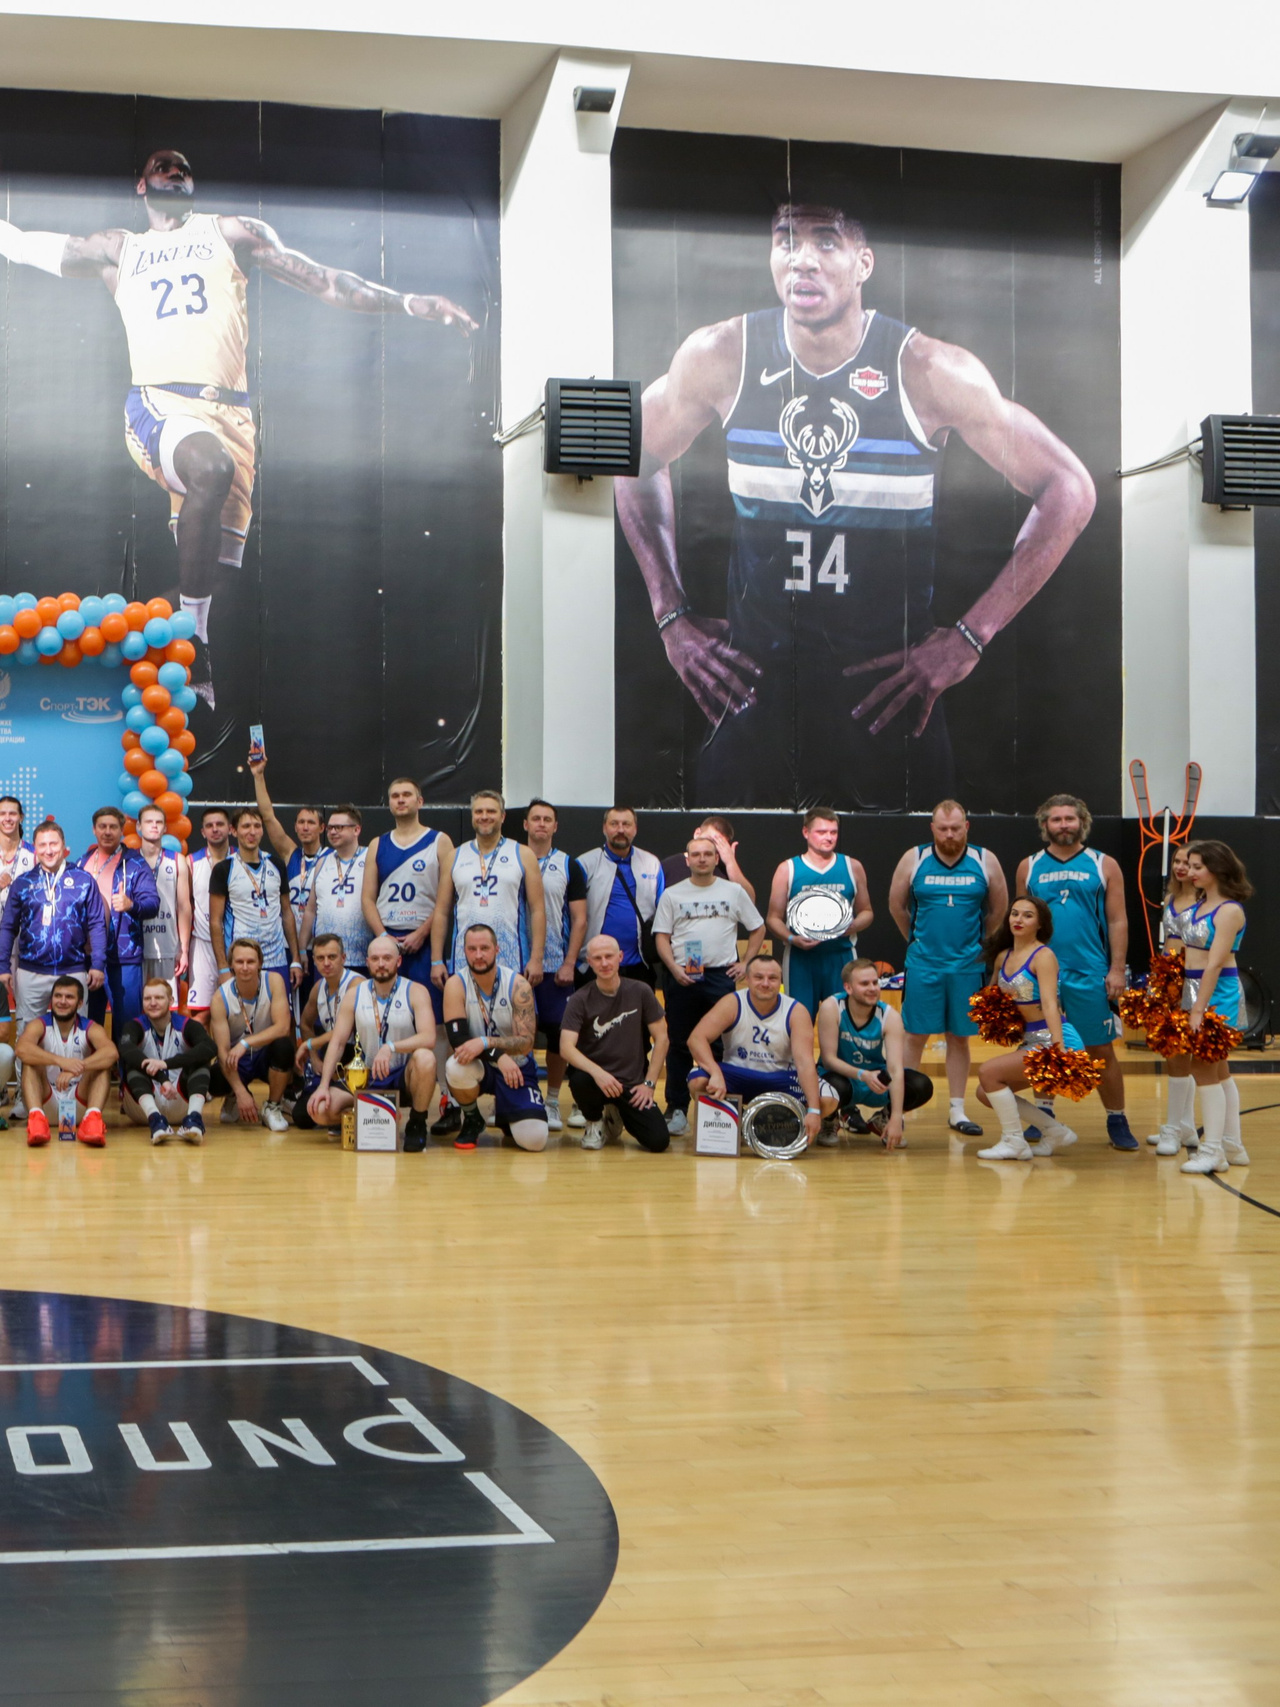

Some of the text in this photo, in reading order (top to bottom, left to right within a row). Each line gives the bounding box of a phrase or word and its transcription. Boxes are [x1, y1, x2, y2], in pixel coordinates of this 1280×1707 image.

[1093, 267, 1103, 285] ALL
[150, 273, 209, 320] 23
[784, 529, 851, 595] 34
[924, 875, 976, 885] СИБУР
[1039, 870, 1090, 883] СИБУР
[388, 882, 417, 903] 20
[1060, 889, 1069, 904] 7
[947, 894, 954, 907] 1
[189, 989, 197, 1003] 2
[1103, 1019, 1113, 1035] 7
[752, 1025, 771, 1047] 24
[362, 1117, 390, 1126] ДИПЛОМ
[703, 1120, 732, 1129] ДИПЛОМ
